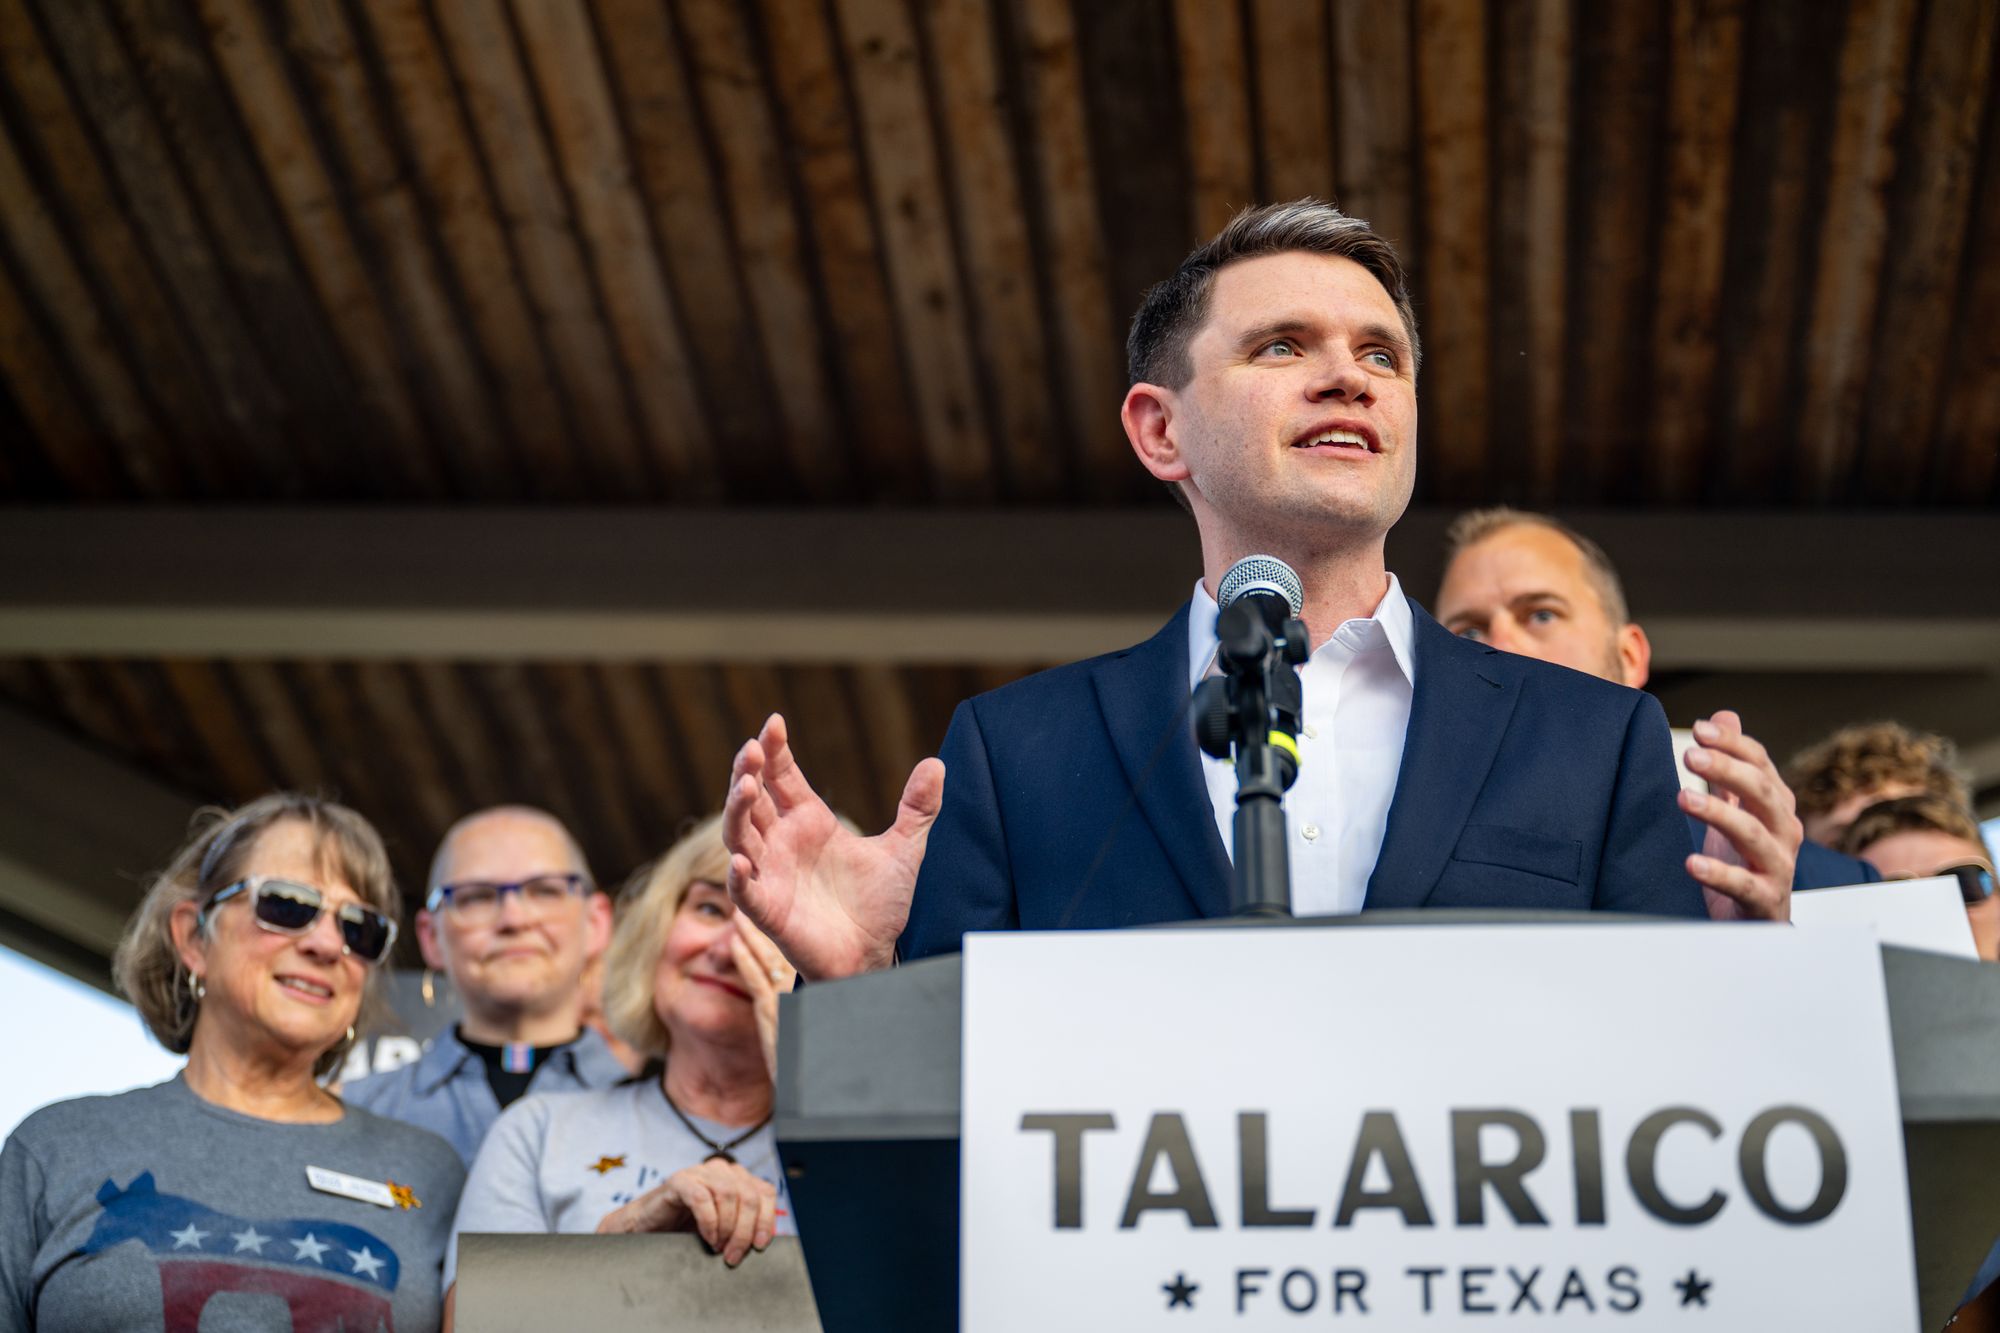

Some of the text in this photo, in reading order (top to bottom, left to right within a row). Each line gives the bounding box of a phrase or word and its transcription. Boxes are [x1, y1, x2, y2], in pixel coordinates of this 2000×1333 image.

[1020, 1106, 1849, 1231] TALARICO
[1235, 1266, 1643, 1315] FOR TEXAS
